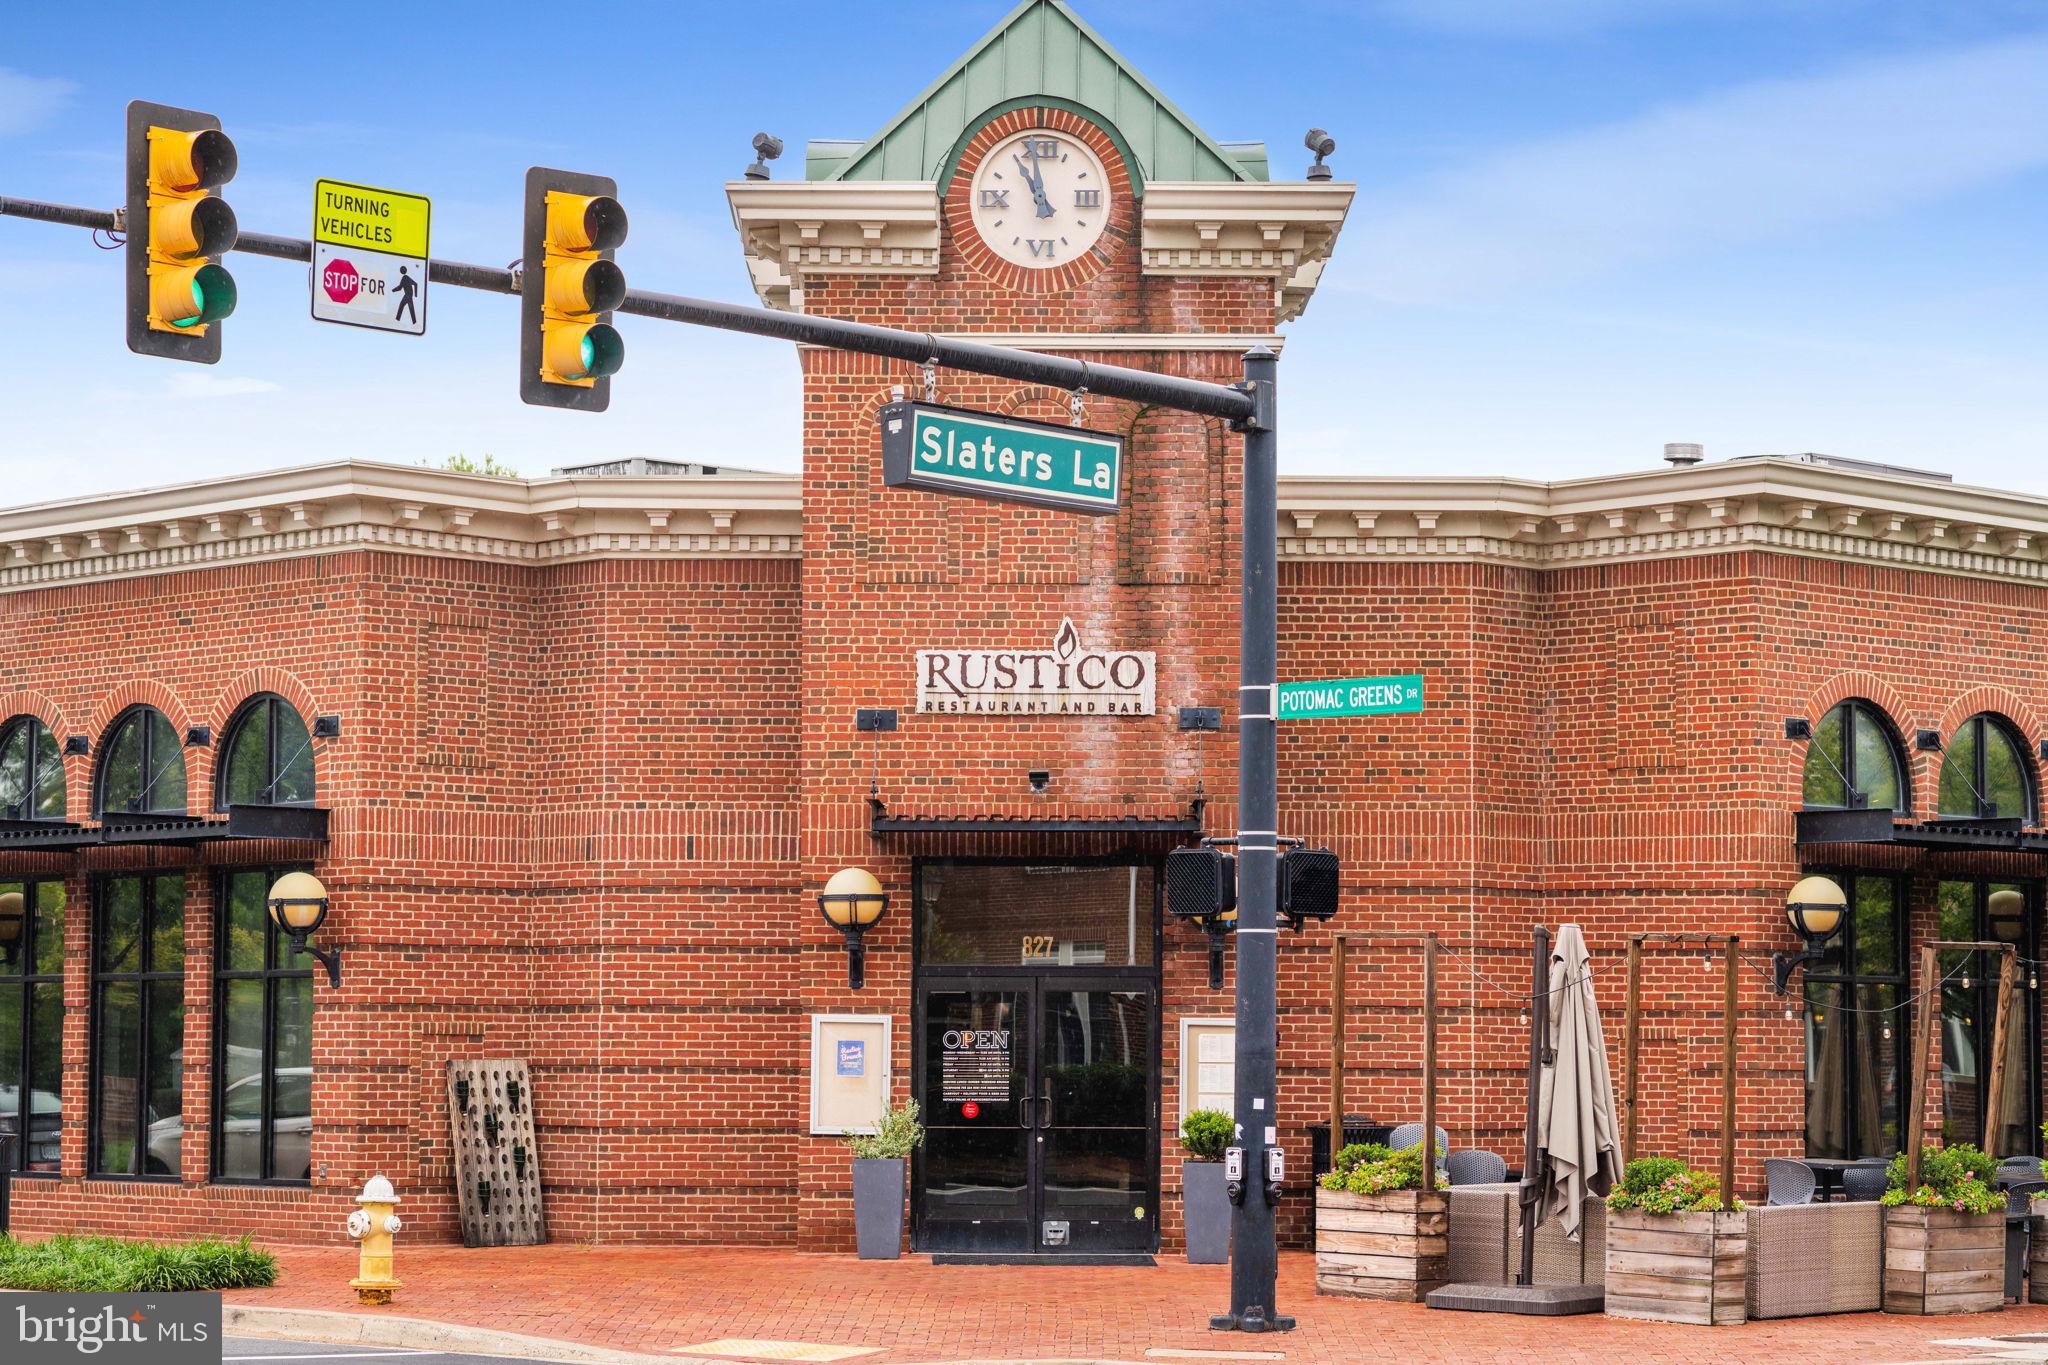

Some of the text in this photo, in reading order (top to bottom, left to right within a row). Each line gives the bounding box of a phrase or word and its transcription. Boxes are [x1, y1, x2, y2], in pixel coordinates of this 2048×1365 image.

[325, 192, 390, 218] TURNING
[979, 189, 1010, 208] IX
[1074, 189, 1101, 208] III
[321, 216, 393, 244] VEHICLES
[1025, 239, 1056, 258] VI
[324, 271, 385, 296] STOP FOR
[920, 425, 1112, 490] Slaters La
[925, 652, 1146, 698] RUSTICO
[925, 700, 1142, 713] RESTAURANT AND BAR
[1280, 684, 1418, 712] POTOMAC GREENS DR
[1022, 935, 1054, 957] 827
[942, 1030, 1010, 1050] OPEN
